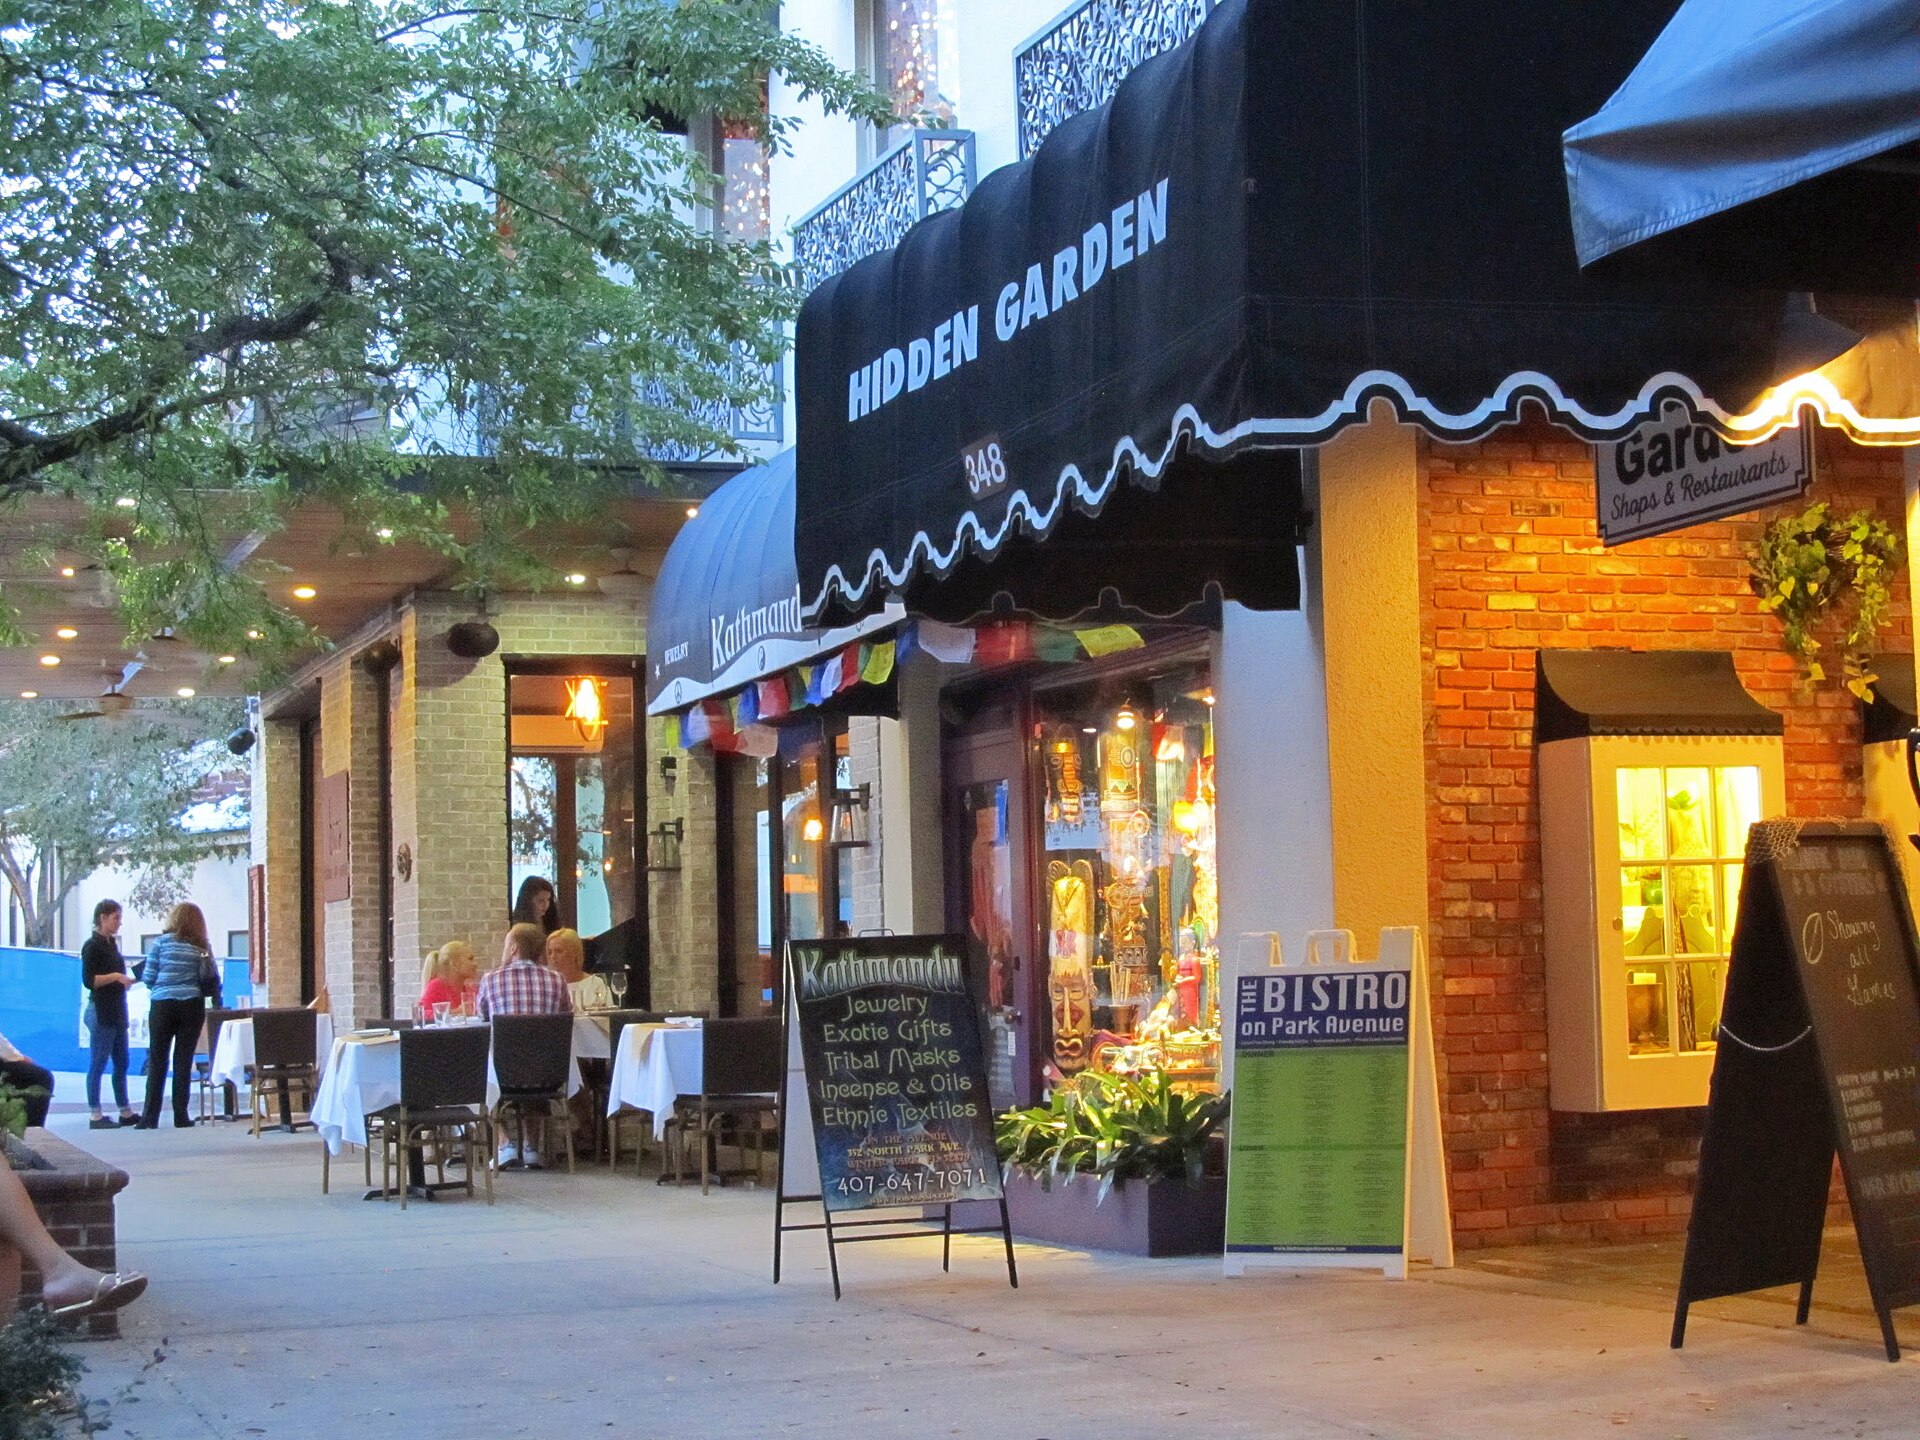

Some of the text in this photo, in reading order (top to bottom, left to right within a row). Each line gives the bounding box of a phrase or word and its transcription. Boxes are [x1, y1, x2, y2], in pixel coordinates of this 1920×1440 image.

[848, 177, 1169, 423] HIDDEN GARDEN
[965, 442, 1007, 494] 348
[1614, 423, 1777, 486] Gard
[1610, 449, 1791, 523] Shops & Restaurants
[664, 641, 689, 666] JEWELRY
[1826, 909, 1881, 951] Showing
[1849, 945, 1872, 969] all
[799, 945, 966, 1001] Kathmandu
[841, 994, 928, 1022] Jewelry
[1240, 972, 1407, 1015] THE BISTRO
[824, 1019, 952, 1045] Exotic Gifts
[1241, 1015, 1405, 1037] on Park Avenue
[824, 1047, 961, 1076] Tribal Masks
[820, 1073, 973, 1101] Incense & Oils
[823, 1101, 978, 1130] Ethnic Textiles
[864, 1131, 948, 1145] ON THE AVENUE
[867, 1145, 903, 1157] NORTH
[907, 1142, 935, 1154] PARK
[837, 1167, 987, 1197] 407-647-7071
